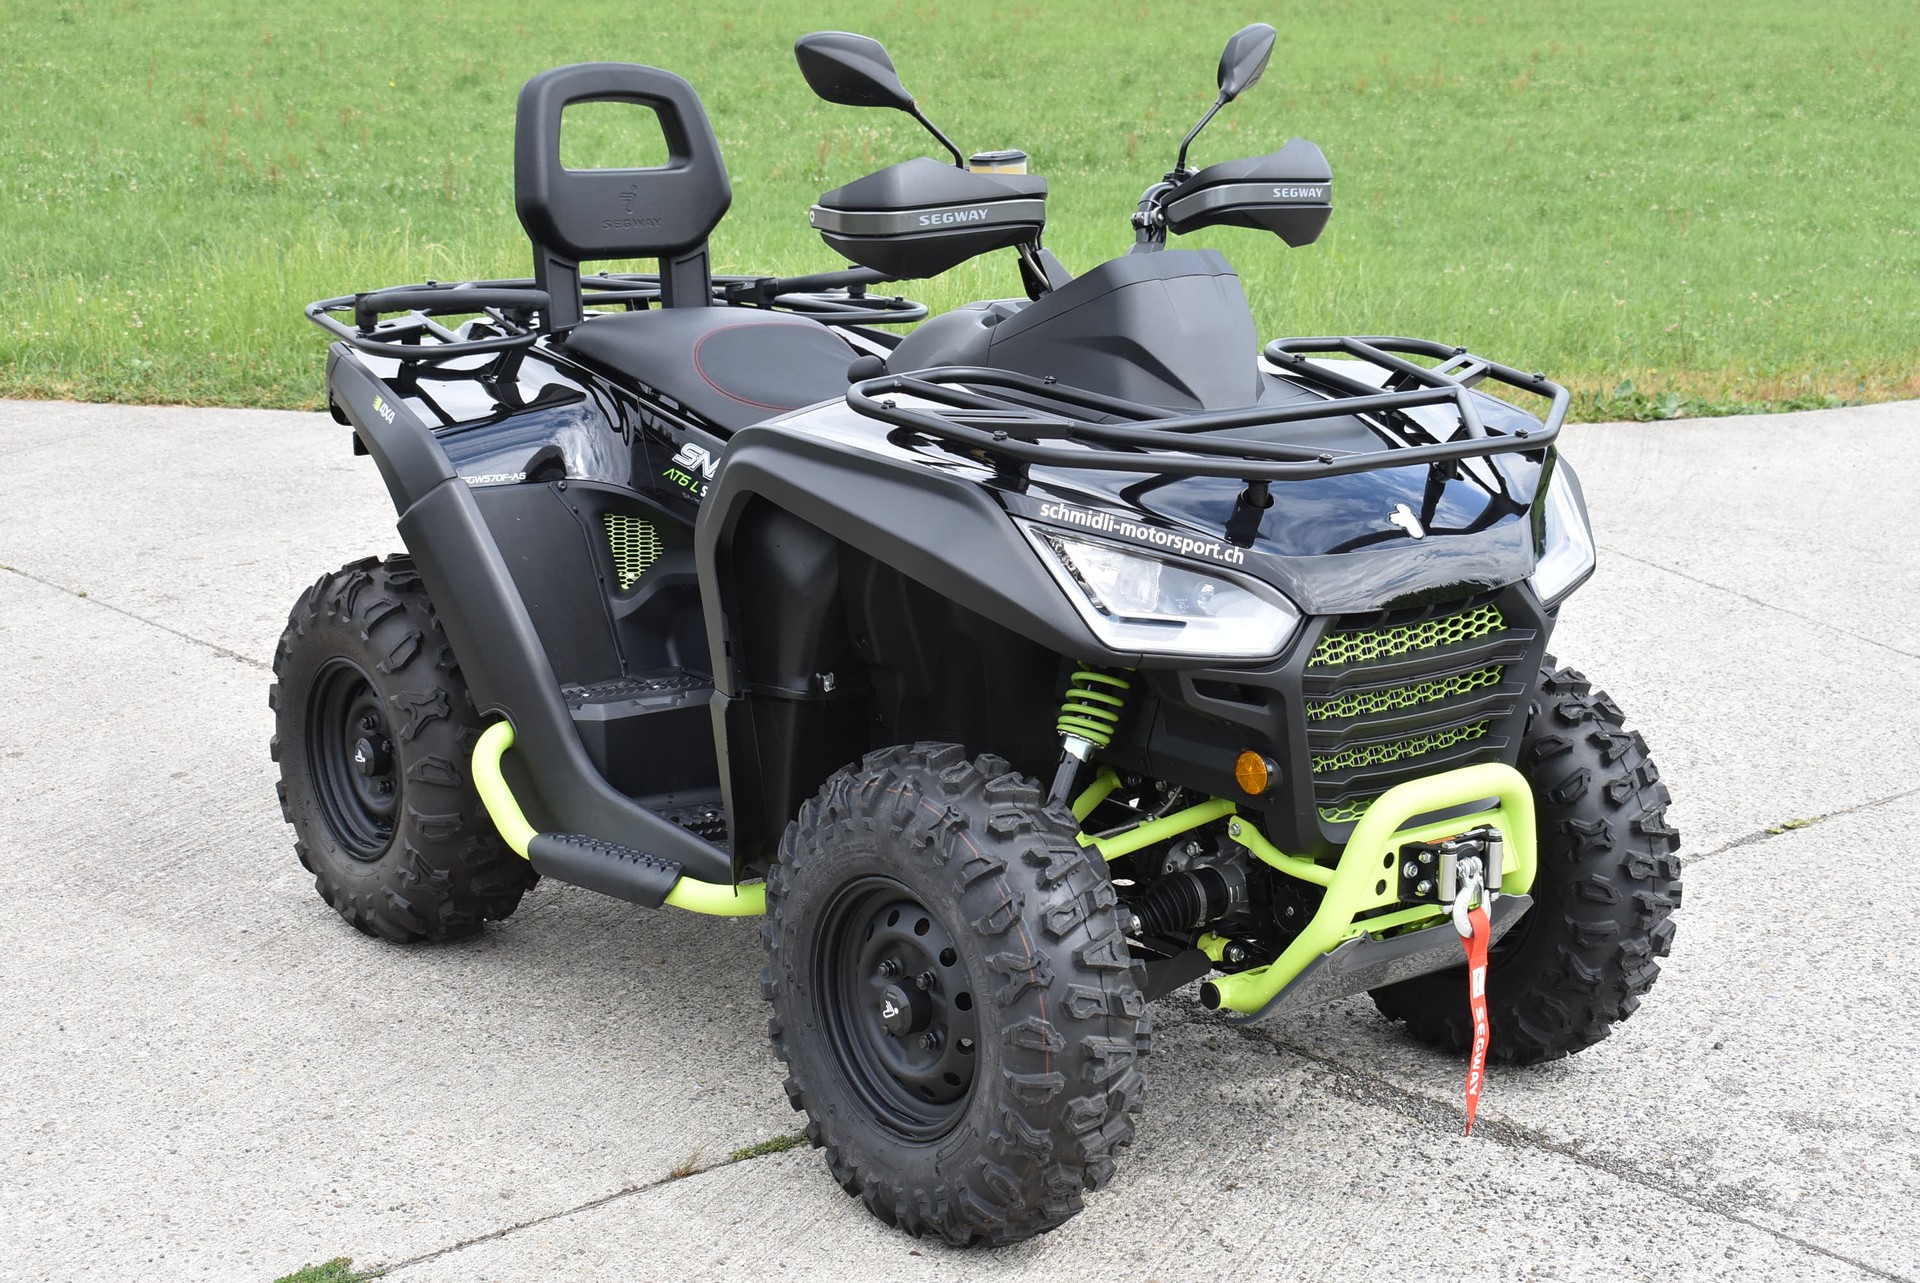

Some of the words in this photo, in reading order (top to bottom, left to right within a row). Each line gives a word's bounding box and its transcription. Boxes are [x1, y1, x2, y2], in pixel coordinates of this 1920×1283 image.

[1272, 187, 1323, 198] SEGWAY
[601, 217, 662, 230] SEGWAY
[919, 208, 988, 226] SEGWAY
[1040, 503, 1244, 564] schmidli-motorsport.ch
[1469, 1006, 1486, 1096] SEGWAY
